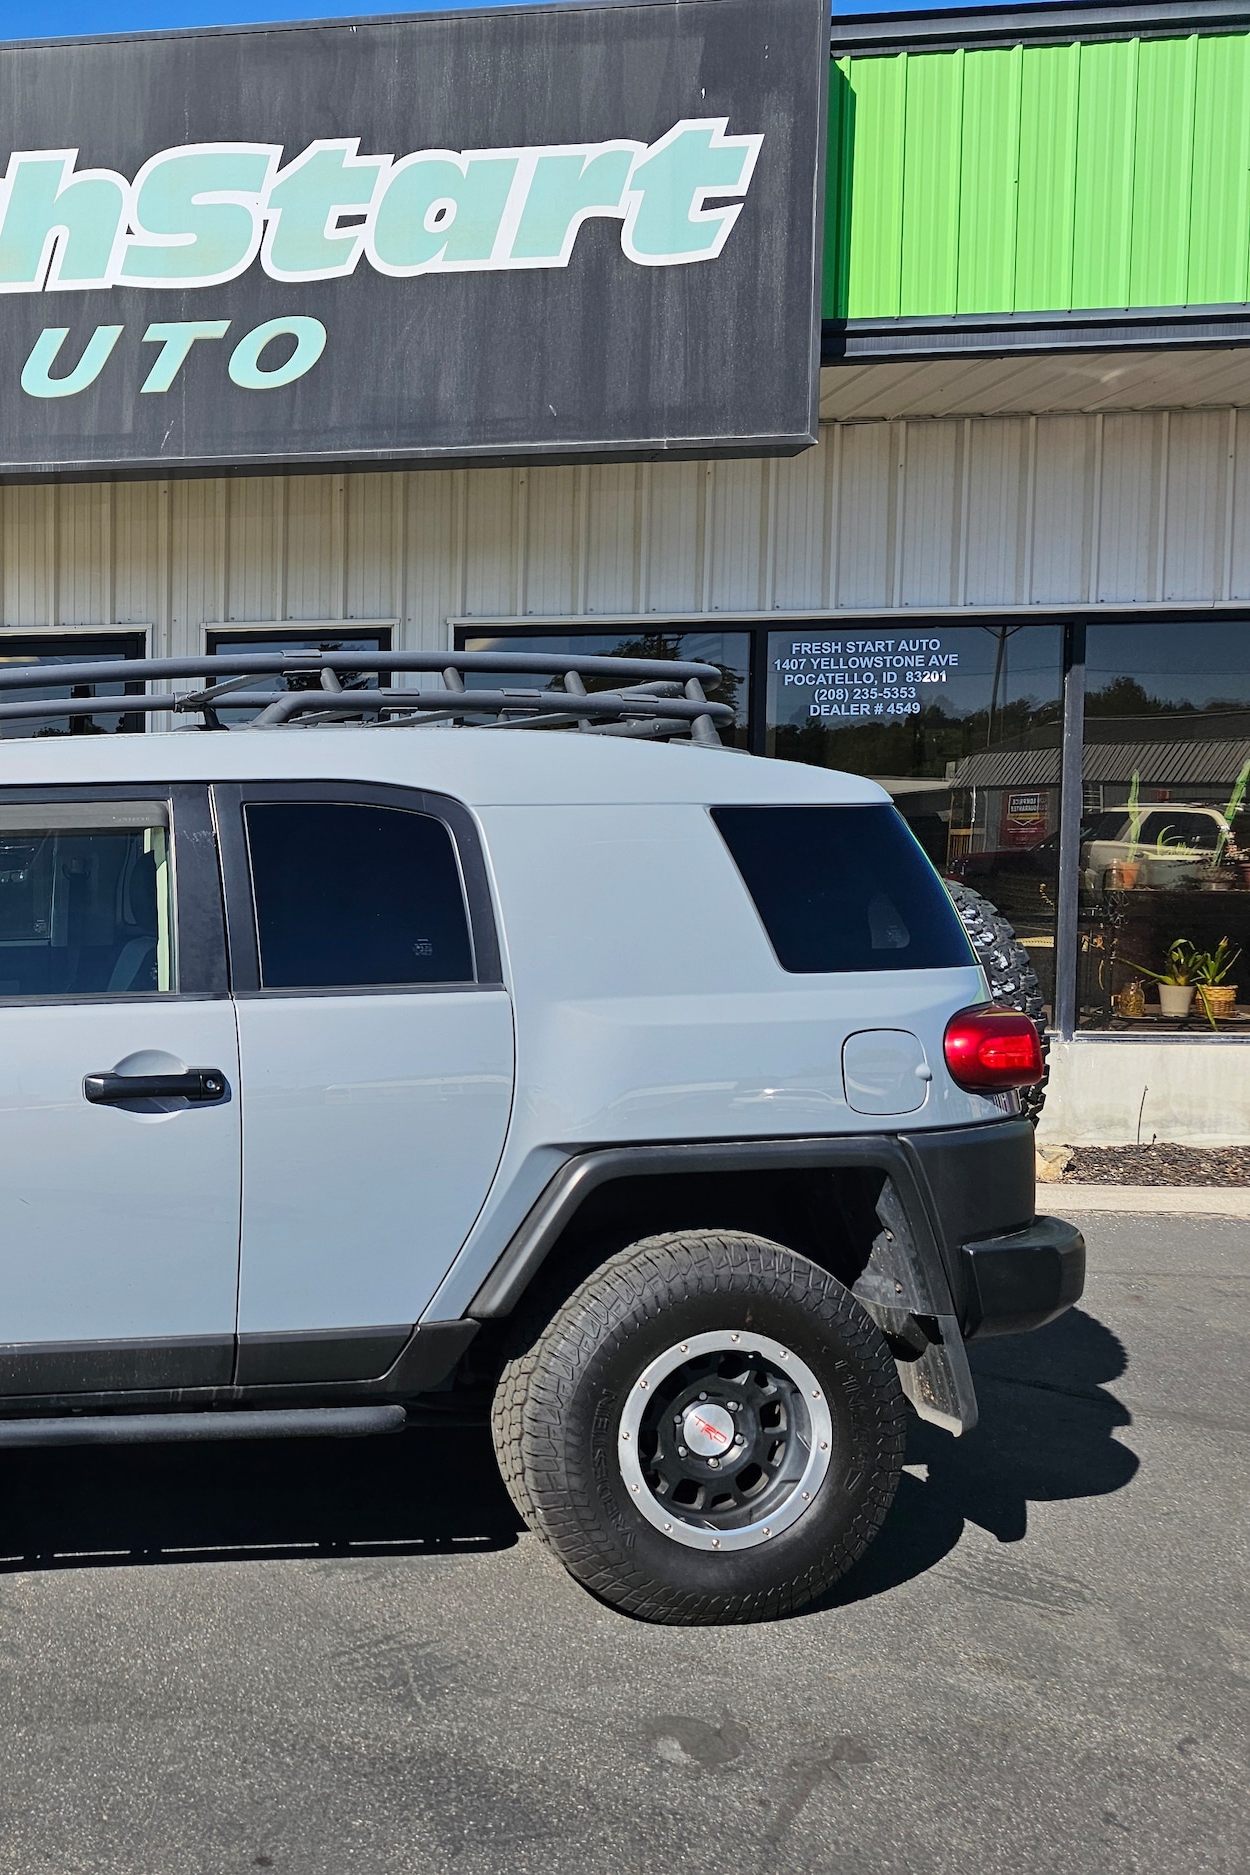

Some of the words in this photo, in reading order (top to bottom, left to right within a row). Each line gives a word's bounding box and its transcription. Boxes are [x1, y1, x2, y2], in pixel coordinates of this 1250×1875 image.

[792, 642, 842, 655] FRESH
[846, 640, 895, 653] START
[898, 638, 941, 652] AUTO
[773, 658, 807, 671] 1407
[811, 655, 925, 670] YELLOWSTONE
[928, 653, 959, 667] AVE
[784, 672, 878, 686] POCATELLO,
[882, 671, 898, 684] ID
[905, 670, 947, 683] 83201
[814, 688, 849, 703] (208)
[853, 686, 917, 701] 235-5353
[810, 704, 871, 717] DEALER
[873, 703, 884, 716] #
[886, 702, 921, 715] 4549
[695, 1415, 727, 1443] TRD
[590, 1387, 636, 1550] VREDESTEIN
